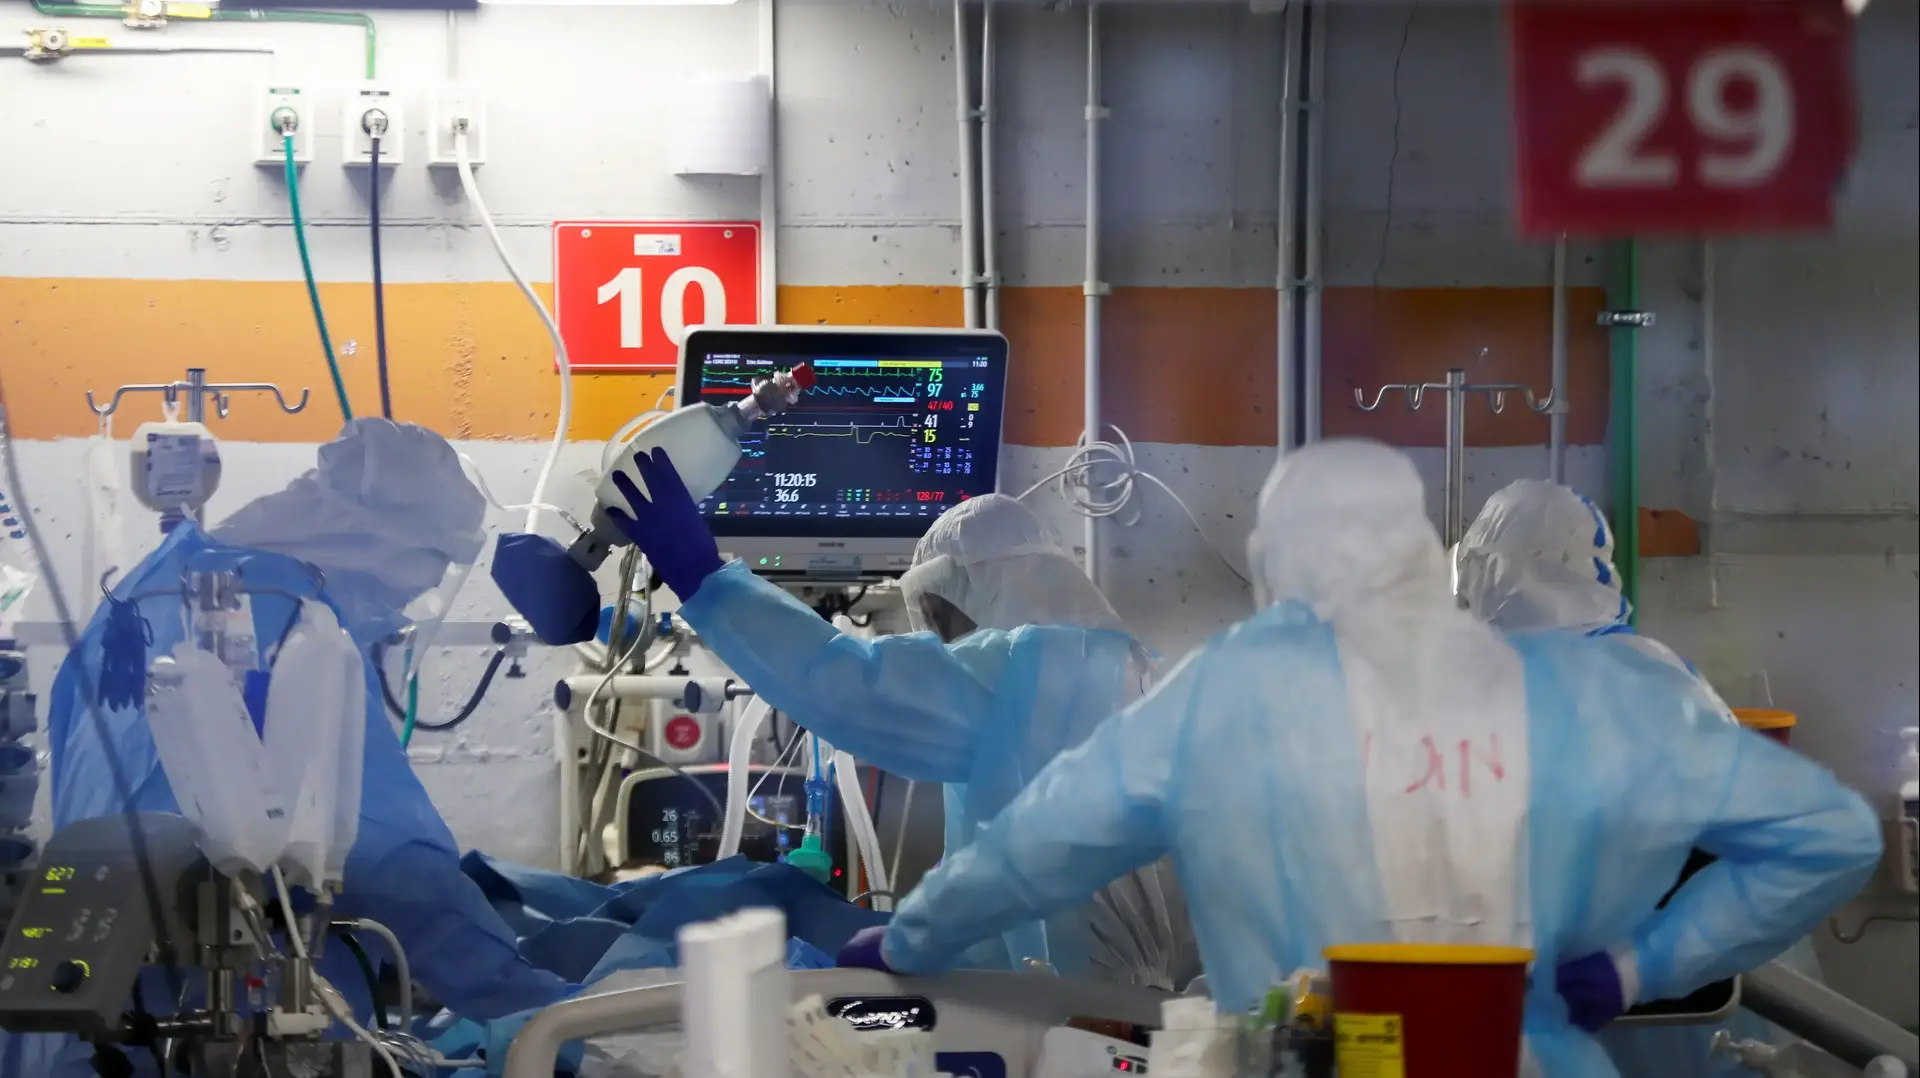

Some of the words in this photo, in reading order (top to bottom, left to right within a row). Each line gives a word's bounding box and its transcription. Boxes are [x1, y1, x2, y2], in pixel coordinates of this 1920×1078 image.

[1574, 47, 1797, 190] 29
[596, 265, 728, 349] 10
[929, 368, 942, 381] 75
[928, 384, 942, 397] 97
[924, 414, 938, 428] 41
[924, 429, 936, 442] 15
[774, 473, 817, 487] 11:20:15
[774, 489, 799, 502] 36.6
[916, 491, 945, 501] 128/77
[662, 810, 678, 822] 26
[652, 831, 679, 843] 0.65
